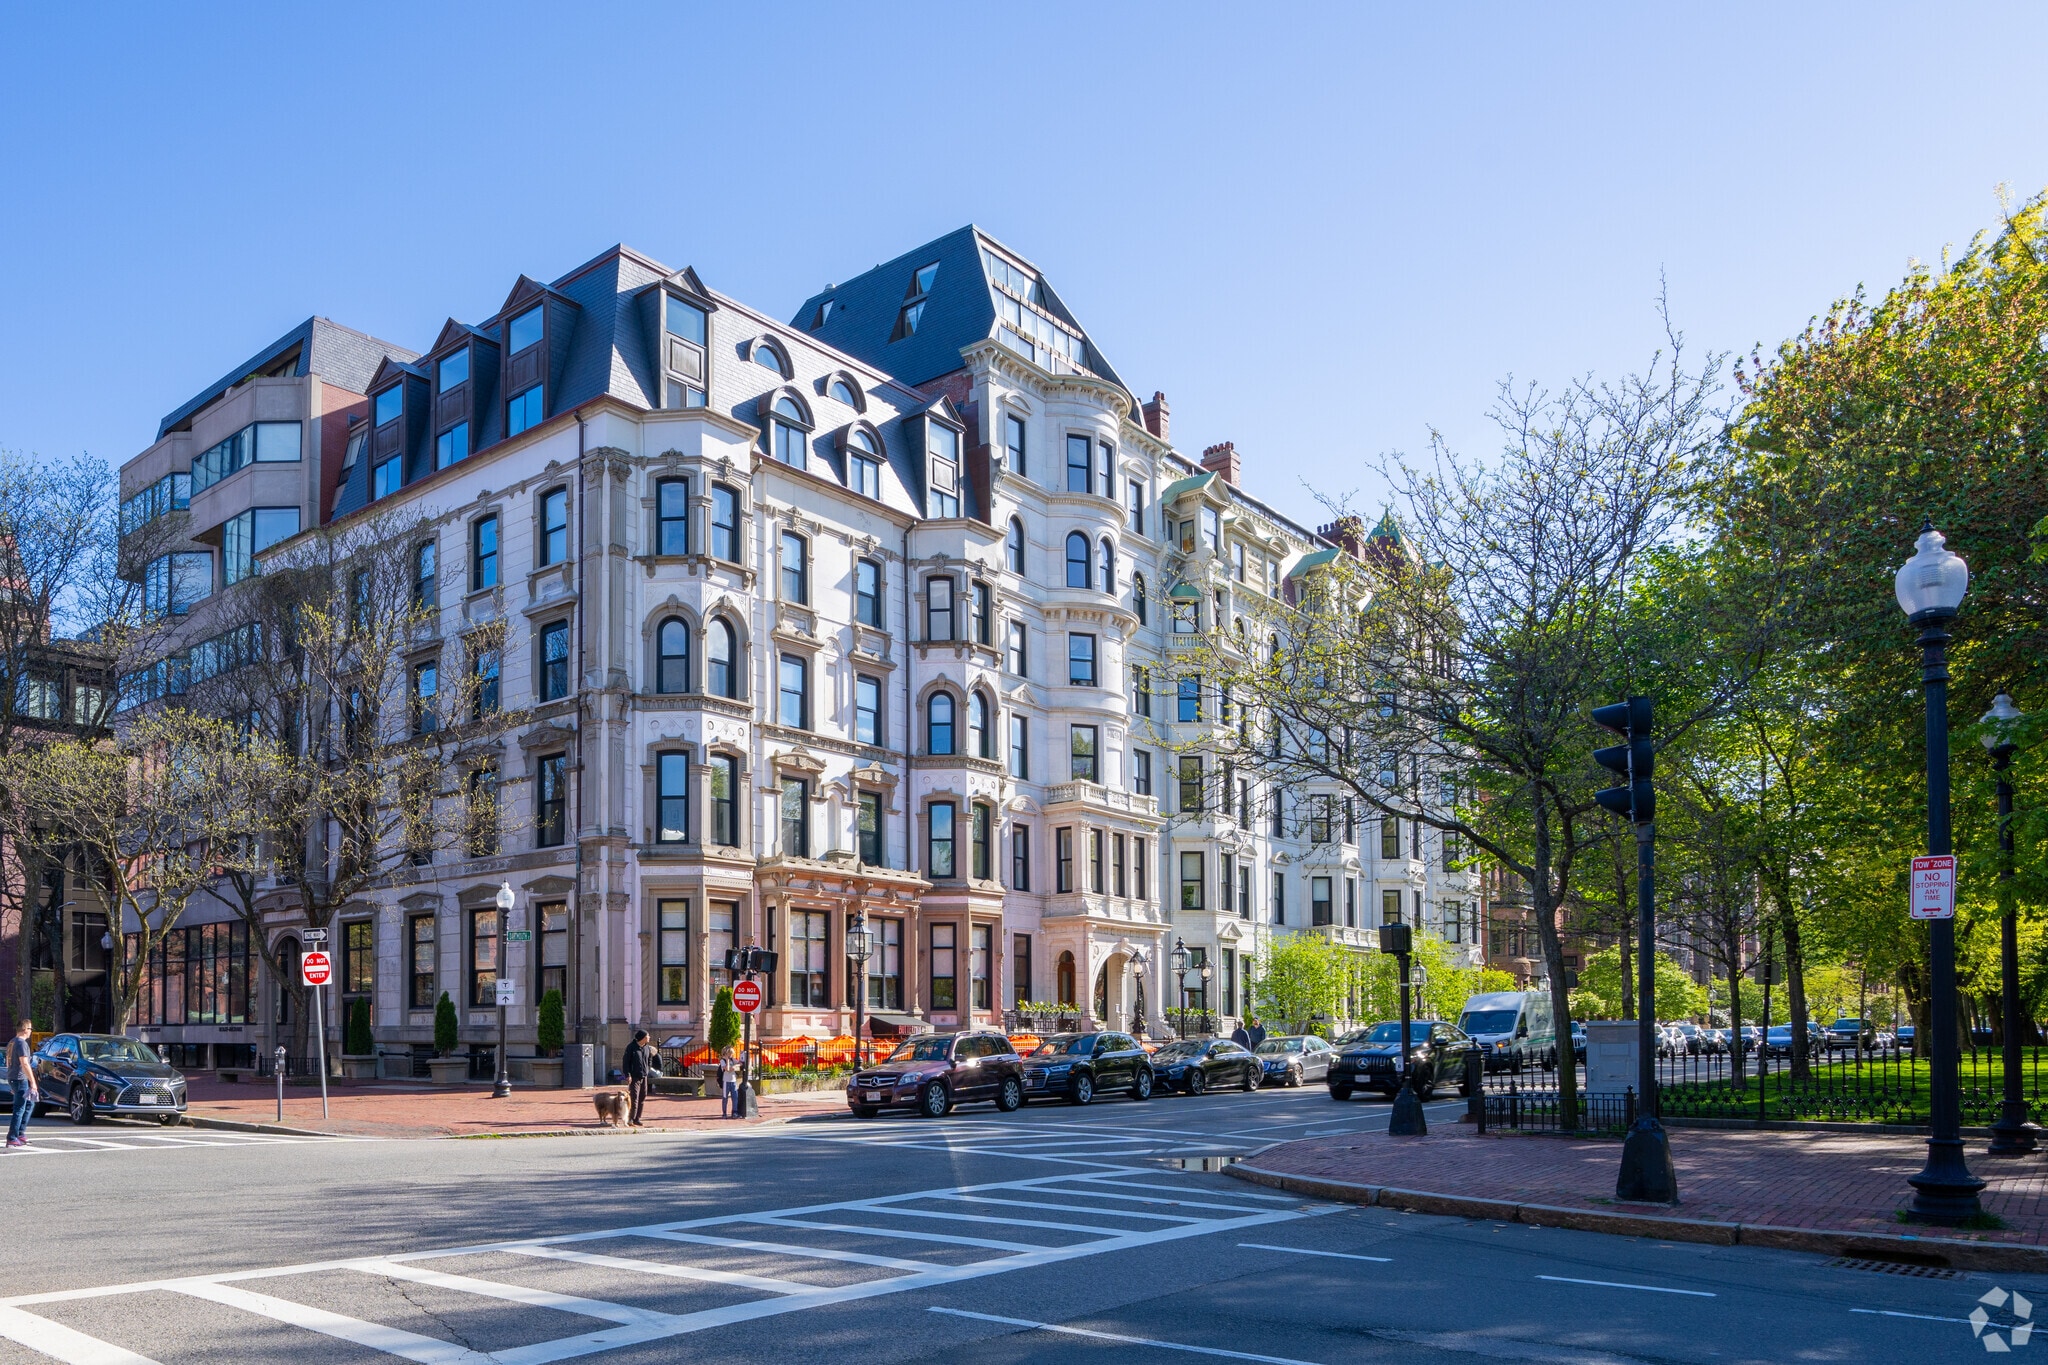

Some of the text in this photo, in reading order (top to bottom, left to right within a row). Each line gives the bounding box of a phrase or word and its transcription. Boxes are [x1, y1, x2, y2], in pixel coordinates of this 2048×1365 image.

[1914, 859, 1952, 869] TOW ZONE
[1924, 872, 1940, 881] NO
